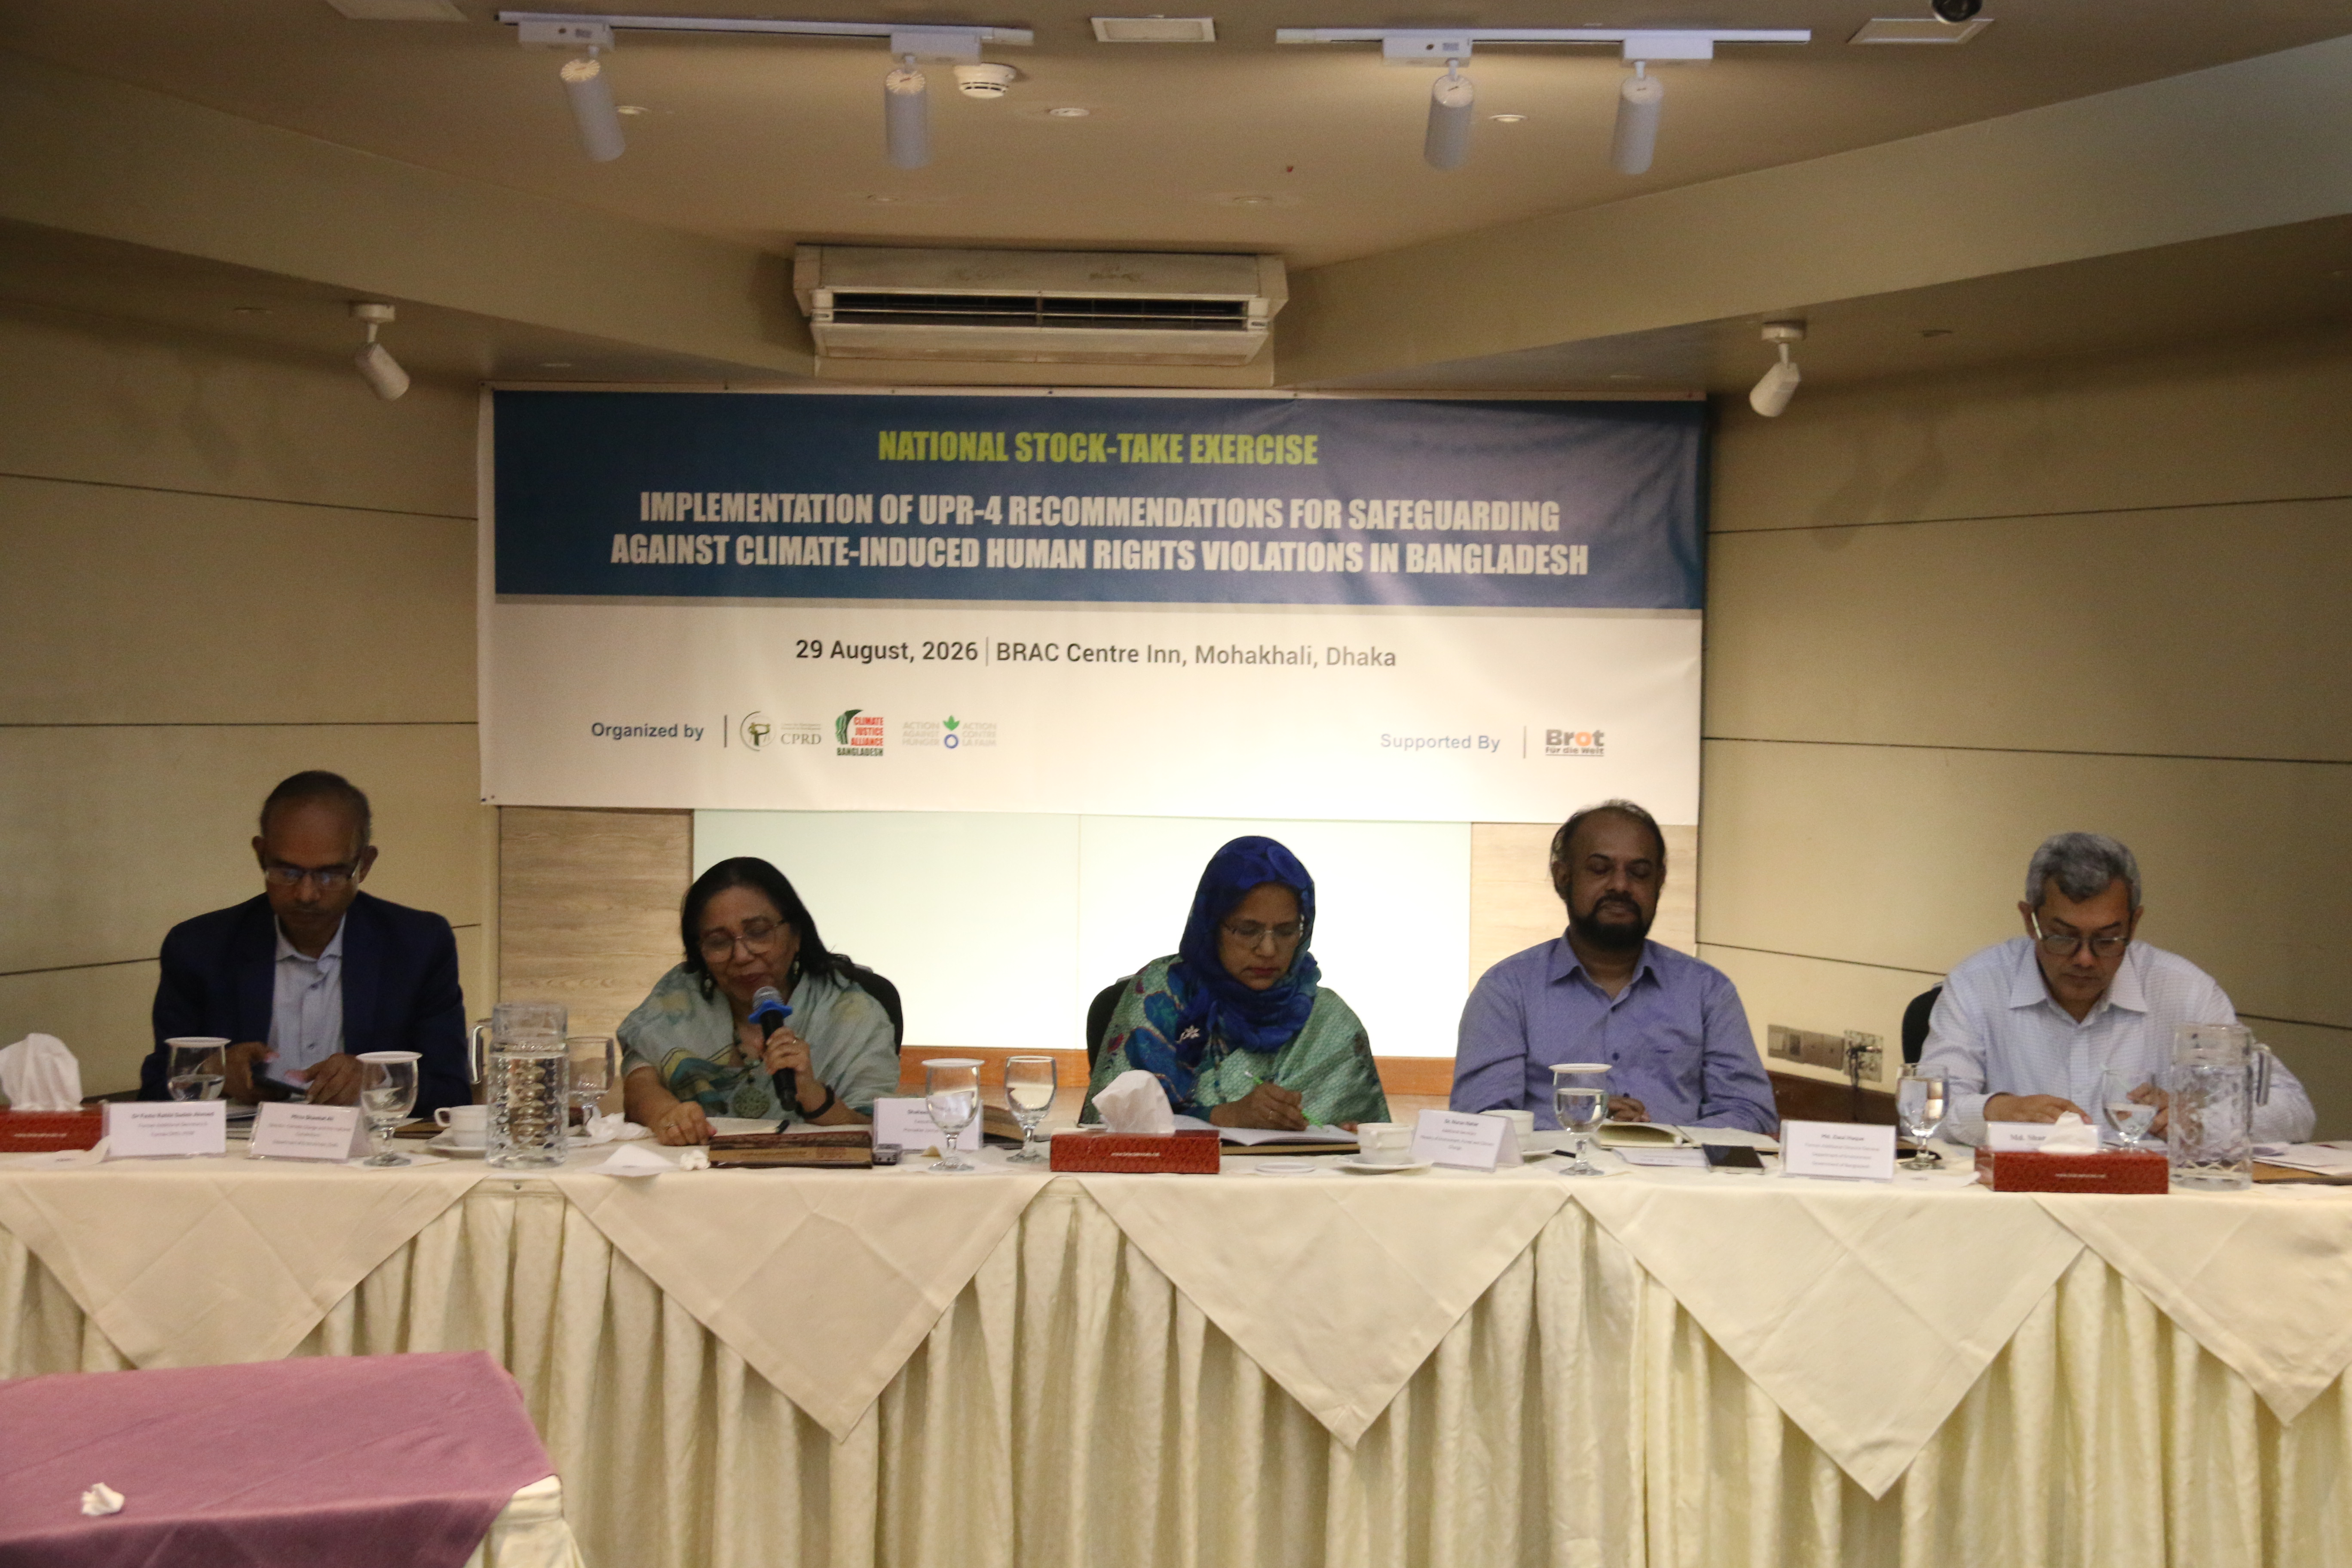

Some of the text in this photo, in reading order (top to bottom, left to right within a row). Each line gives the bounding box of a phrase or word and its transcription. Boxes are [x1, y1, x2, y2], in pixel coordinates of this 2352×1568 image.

[878, 431, 1318, 465] NATIONAL STOCK-TAKE EXERCISE
[640, 491, 1560, 533] IMPLEMENTATION OF UPR-4 RECOMMENDATIONS FOR SAFEGUARDING
[610, 533, 1588, 576] AGAINST CLIMATE-INDUCED HUMAN RIGHTS VIOLATIONS IN BANGLADESH
[796, 639, 1396, 670] 29 August, 2026 BRAC Centre Inn, Mohakhali, Dhaka
[854, 717, 883, 726] CLIMATE
[855, 727, 883, 735] JUSTICE
[591, 722, 704, 742] Organized by
[781, 733, 821, 744] CPRD
[1546, 729, 1605, 747] Brot
[837, 747, 883, 756] BANGLADESH
[851, 738, 883, 746] ALLIANCE
[1381, 733, 1501, 753] Supported By
